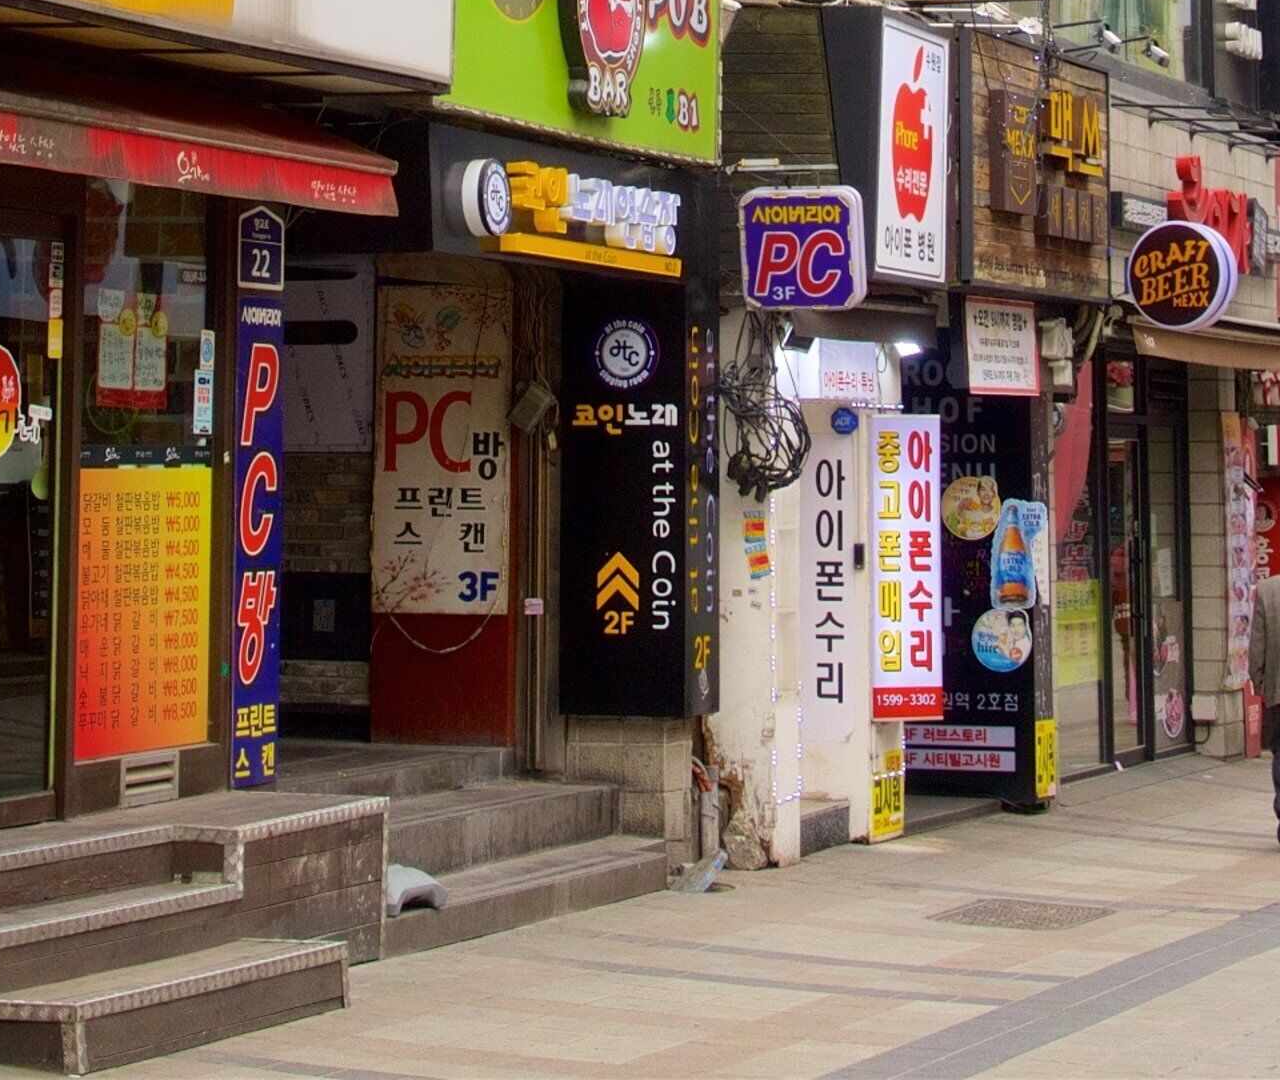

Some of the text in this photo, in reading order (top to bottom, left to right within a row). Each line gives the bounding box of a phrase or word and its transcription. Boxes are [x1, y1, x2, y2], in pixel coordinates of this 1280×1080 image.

[587, 63, 630, 107] BAR
[677, 93, 701, 132] B1
[895, 120, 919, 152] iPhone
[1005, 127, 1036, 160] MEXX
[1050, 90, 1104, 178] 맥쓰
[896, 168, 928, 198] 수리전문
[885, 223, 913, 259] 아이폰
[251, 248, 271, 278] 22
[754, 229, 845, 299] PC
[1133, 239, 1211, 279] CRAFT
[772, 285, 796, 302] 3F
[1139, 262, 1210, 307] BEER
[1172, 290, 1210, 308] MEXX
[613, 319, 627, 328] the
[627, 320, 647, 334] coin
[629, 369, 650, 387] room
[571, 403, 679, 435] 코인노래
[911, 396, 985, 424] HOF
[382, 389, 504, 481] PC 방
[238, 342, 280, 687] PC방
[394, 486, 486, 517] 프린트
[1021, 513, 1042, 521] EXTRA
[393, 522, 486, 554] 스캔
[650, 439, 677, 631] at the Coin
[1023, 520, 1041, 528] COLD
[876, 429, 903, 674] 중고폰매입
[907, 429, 933, 673] 아이폰수리
[458, 571, 500, 603] 3F
[814, 458, 846, 705] 아이폰수리
[603, 610, 635, 634] 2F
[694, 635, 711, 669] 2F
[876, 693, 937, 707] 1599-3302
[975, 692, 1019, 712] 2호점
[235, 703, 277, 739] 프린트
[923, 727, 987, 743] 러브스토리
[234, 748, 276, 781] 스캔
[922, 752, 1001, 768] 시티빌고시원
[873, 778, 901, 814] 고시원
